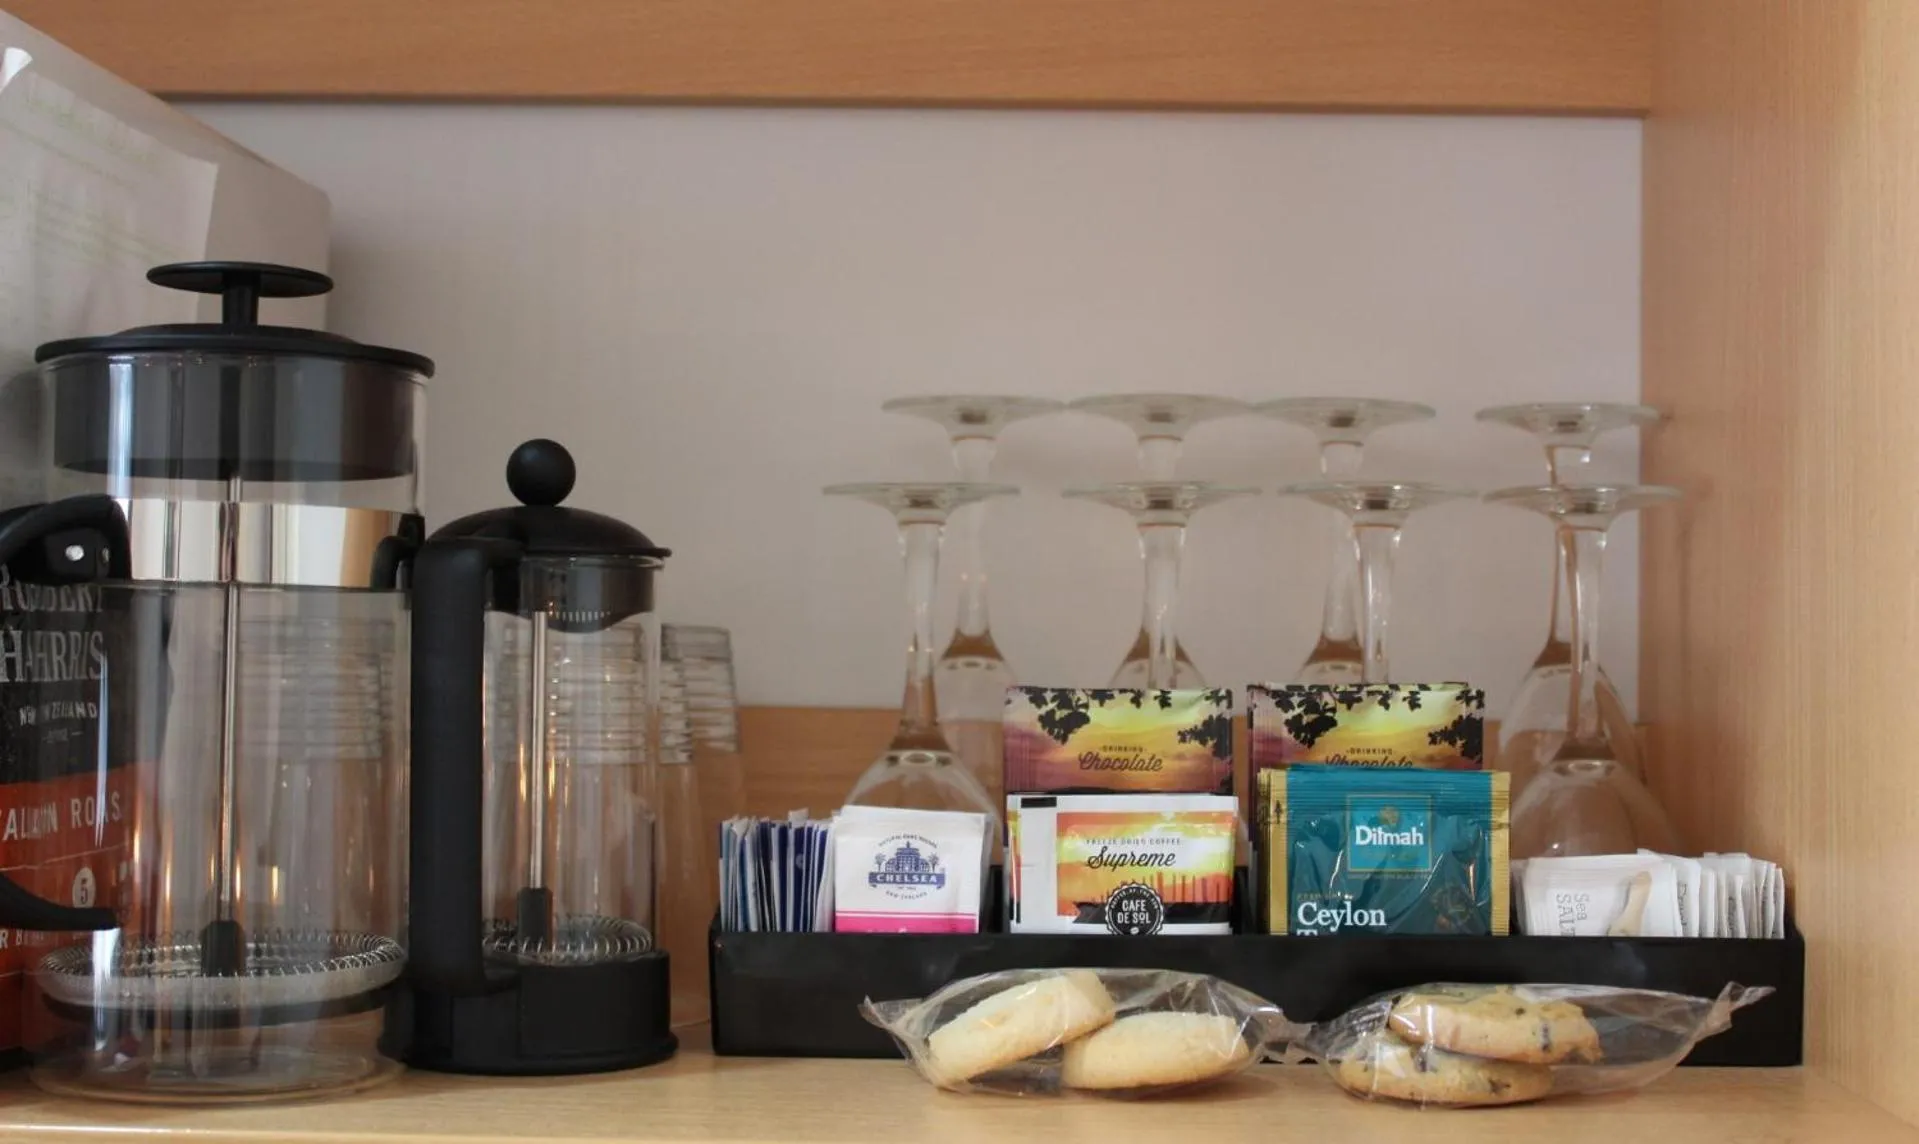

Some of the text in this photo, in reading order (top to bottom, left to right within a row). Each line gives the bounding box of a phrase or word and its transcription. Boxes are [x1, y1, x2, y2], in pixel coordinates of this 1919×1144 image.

[0, 629, 105, 683] HARRIS
[1078, 750, 1163, 772] Chocolate
[1354, 825, 1424, 846] Dilmah
[1085, 845, 1176, 873] Supreme
[876, 873, 938, 883] CHELSEA
[1122, 899, 1147, 911] CAFE
[1117, 911, 1130, 924] DE
[1297, 900, 1387, 932] Ceylon
